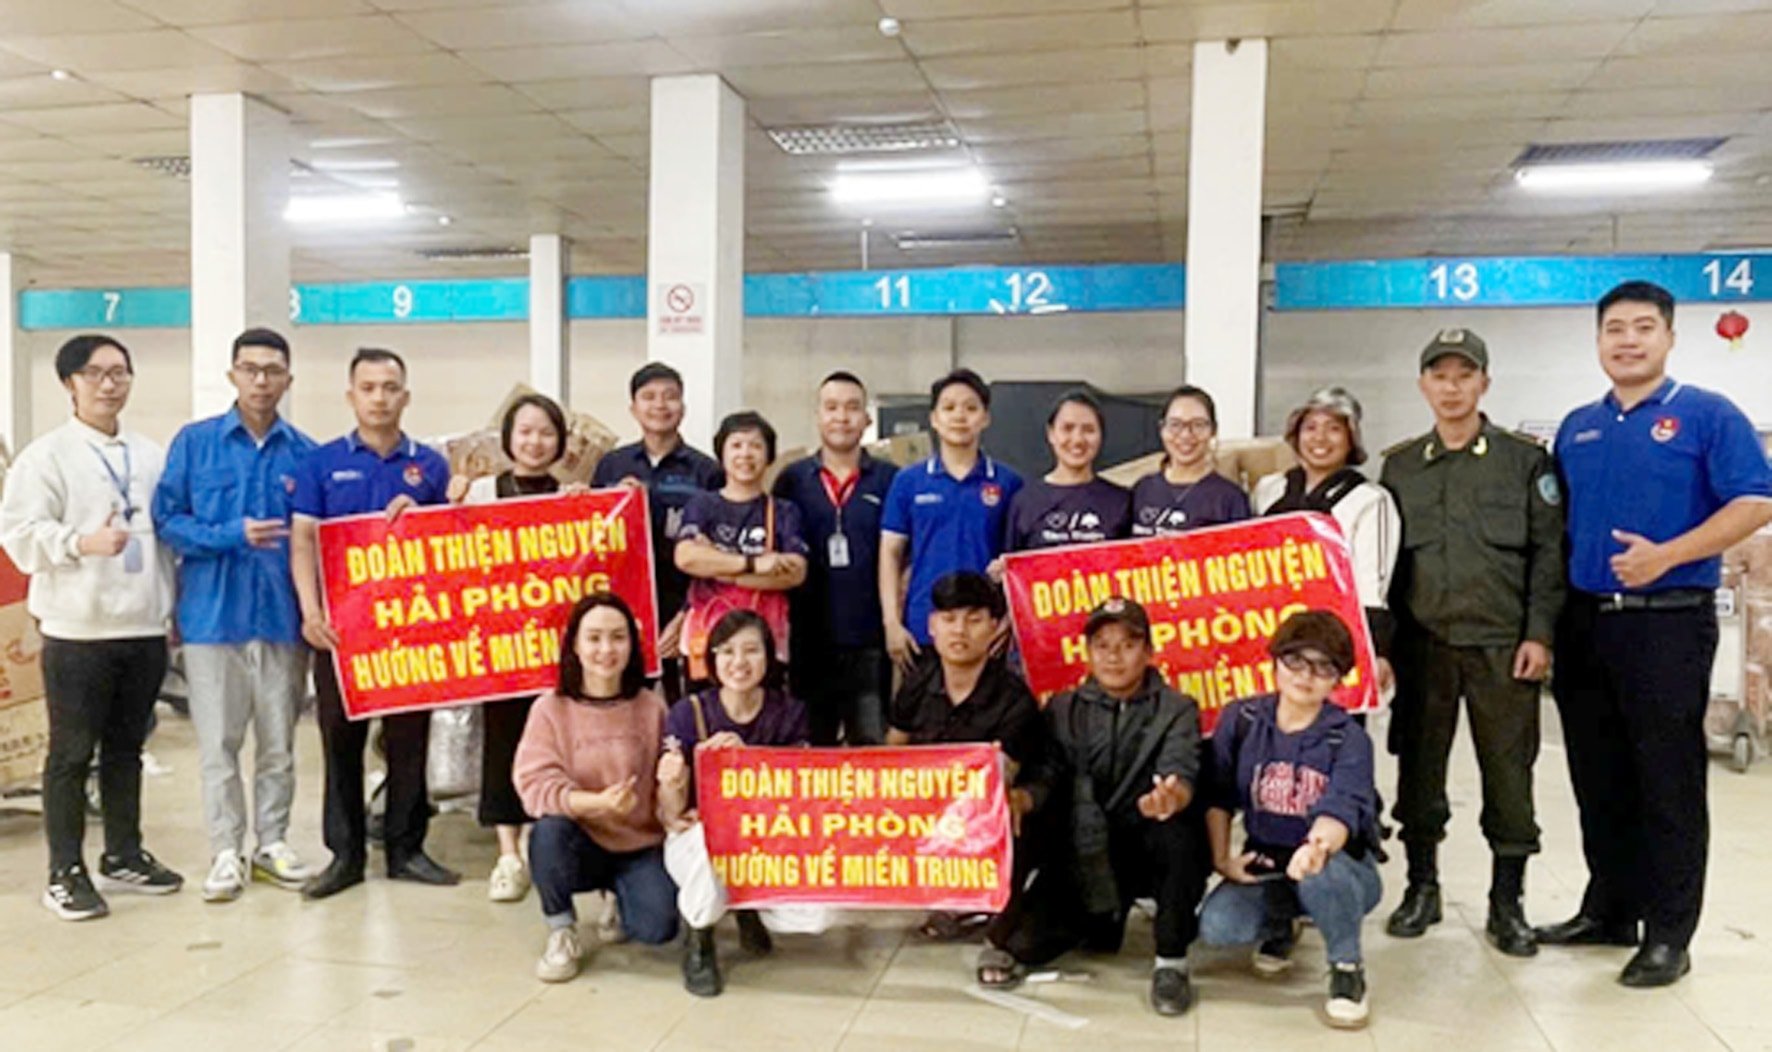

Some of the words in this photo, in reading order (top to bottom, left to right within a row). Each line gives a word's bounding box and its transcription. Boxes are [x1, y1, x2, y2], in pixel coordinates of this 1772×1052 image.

[874, 276, 911, 309] 11
[1005, 272, 1051, 307] 12
[1429, 262, 1479, 300] 13
[1702, 259, 1754, 296] 14
[102, 293, 122, 321] 7
[393, 285, 413, 319] 9
[347, 534, 426, 585] ĐOÀN
[430, 524, 515, 575] THIỆN
[518, 511, 628, 562] NGUYỆN
[1032, 565, 1111, 619] ĐOÀN
[1114, 556, 1202, 610] THIỆN
[1208, 537, 1328, 592] NGUYỆN
[374, 584, 452, 630] HẢI
[721, 761, 794, 799] ĐOÀN
[797, 761, 876, 808] THIỆN
[740, 803, 811, 838] HẢI
[822, 808, 967, 840] PHÒNG
[915, 854, 999, 890] TRUNG
